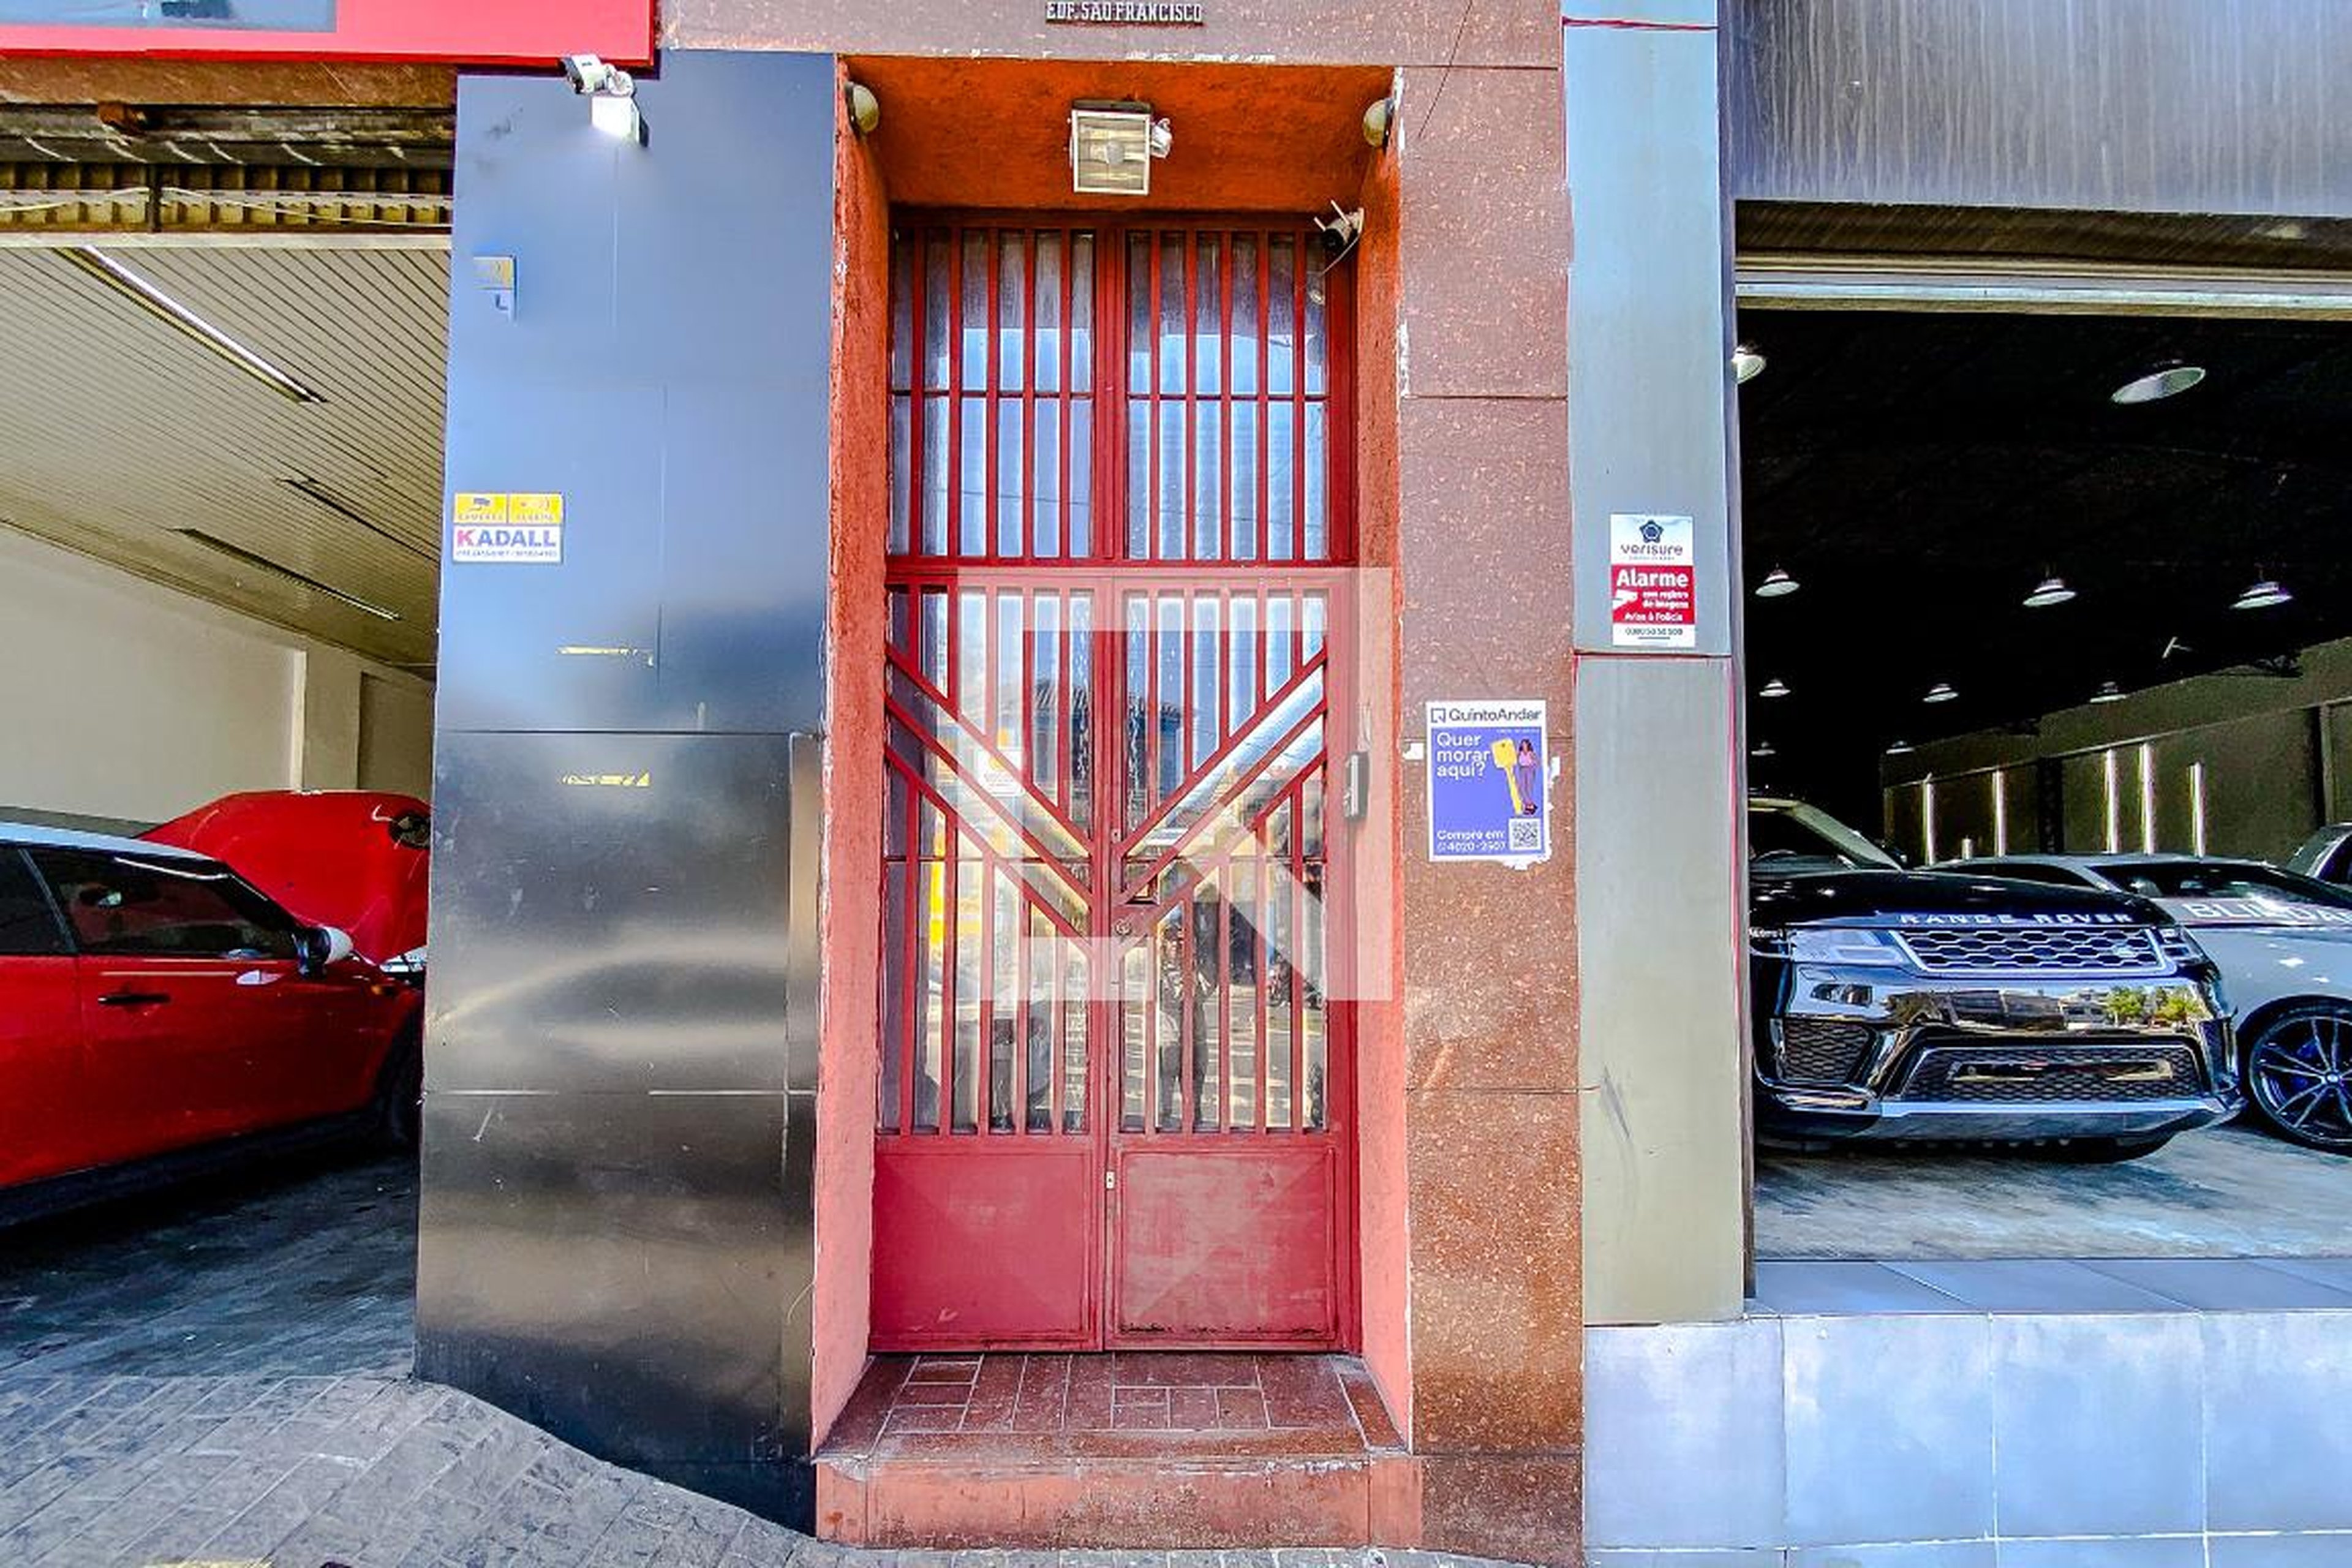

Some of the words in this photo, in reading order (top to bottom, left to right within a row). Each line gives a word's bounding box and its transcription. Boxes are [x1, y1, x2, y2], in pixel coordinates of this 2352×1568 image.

[1115, 2, 1202, 23] FRANCISCO
[456, 529, 557, 548] KADALL
[1620, 545, 1683, 556] verisure
[1617, 568, 1689, 587] Alarme
[1449, 708, 1542, 722] QuintoAndar
[1437, 732, 1482, 748] Quer
[1437, 750, 1491, 763] morar
[1437, 762, 1486, 780] aqui?
[1900, 913, 2018, 924] RANGE
[2033, 913, 2134, 924] ROVER
